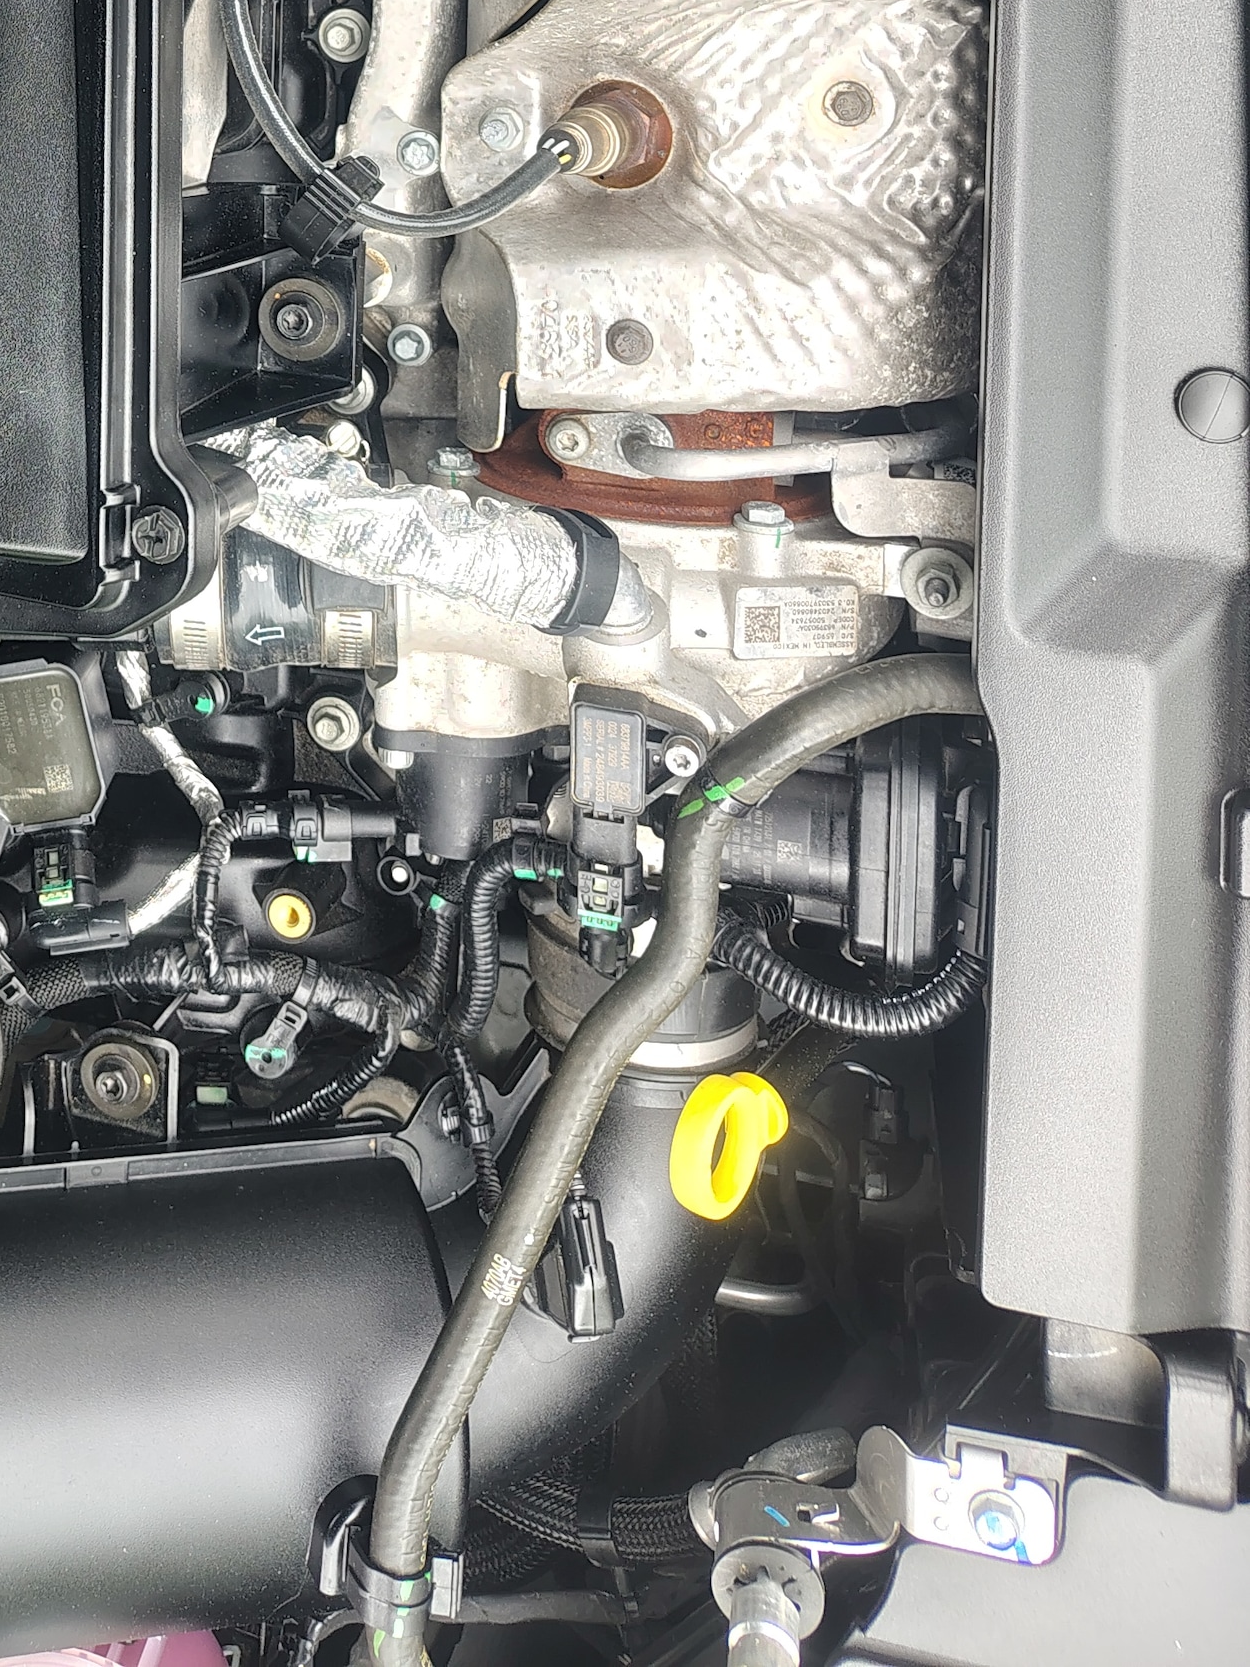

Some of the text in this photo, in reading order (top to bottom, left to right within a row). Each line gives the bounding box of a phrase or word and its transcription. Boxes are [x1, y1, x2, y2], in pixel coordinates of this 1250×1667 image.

[773, 642, 799, 650] MEXICO
[46, 684, 67, 726] FCA
[481, 1253, 511, 1300] 4070AB
[496, 1264, 527, 1306] GMET4
